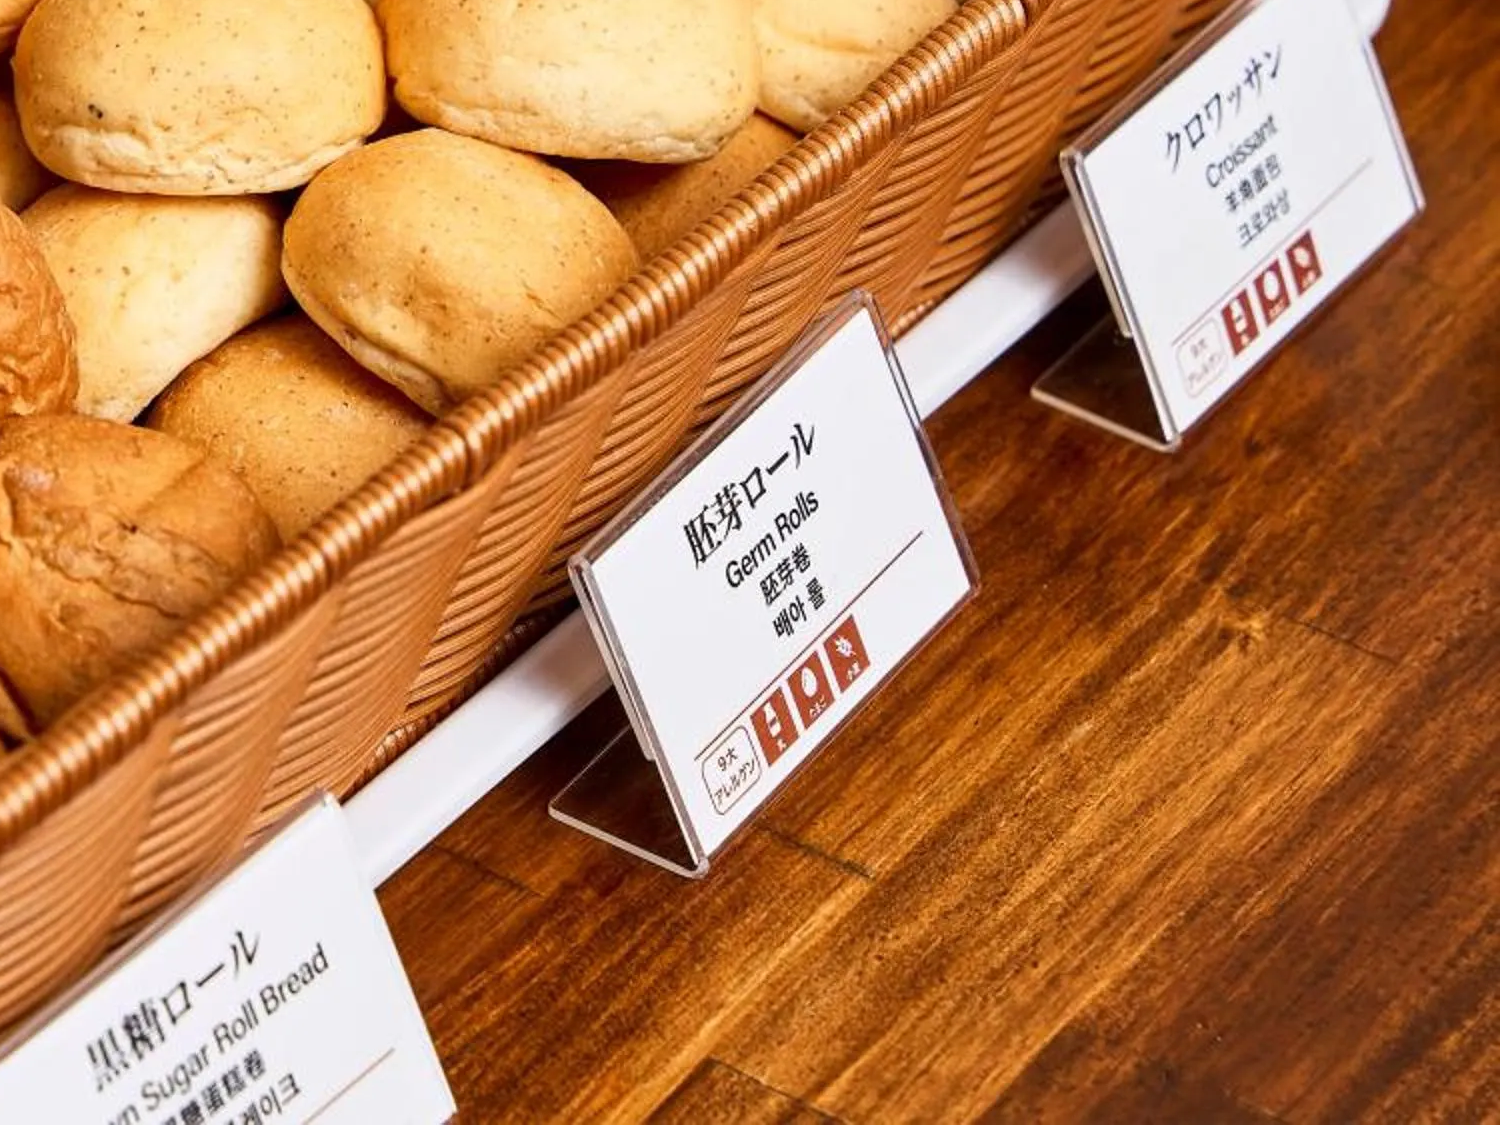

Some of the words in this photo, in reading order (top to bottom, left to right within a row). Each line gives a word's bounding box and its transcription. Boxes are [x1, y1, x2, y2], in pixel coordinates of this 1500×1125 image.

[1167, 44, 1282, 173] クロワッサン
[1205, 114, 1278, 188] Croissant
[683, 423, 815, 569] 胚芽ロール
[725, 532, 777, 588] Germ
[773, 490, 819, 542] Rolls
[772, 595, 808, 637] 배아
[805, 577, 826, 611] 롤
[713, 758, 756, 806] アレルゲン
[717, 746, 738, 772] 9大
[140, 1044, 209, 1112] Sugar
[212, 998, 259, 1055] Roll
[259, 941, 329, 1016] Bread
